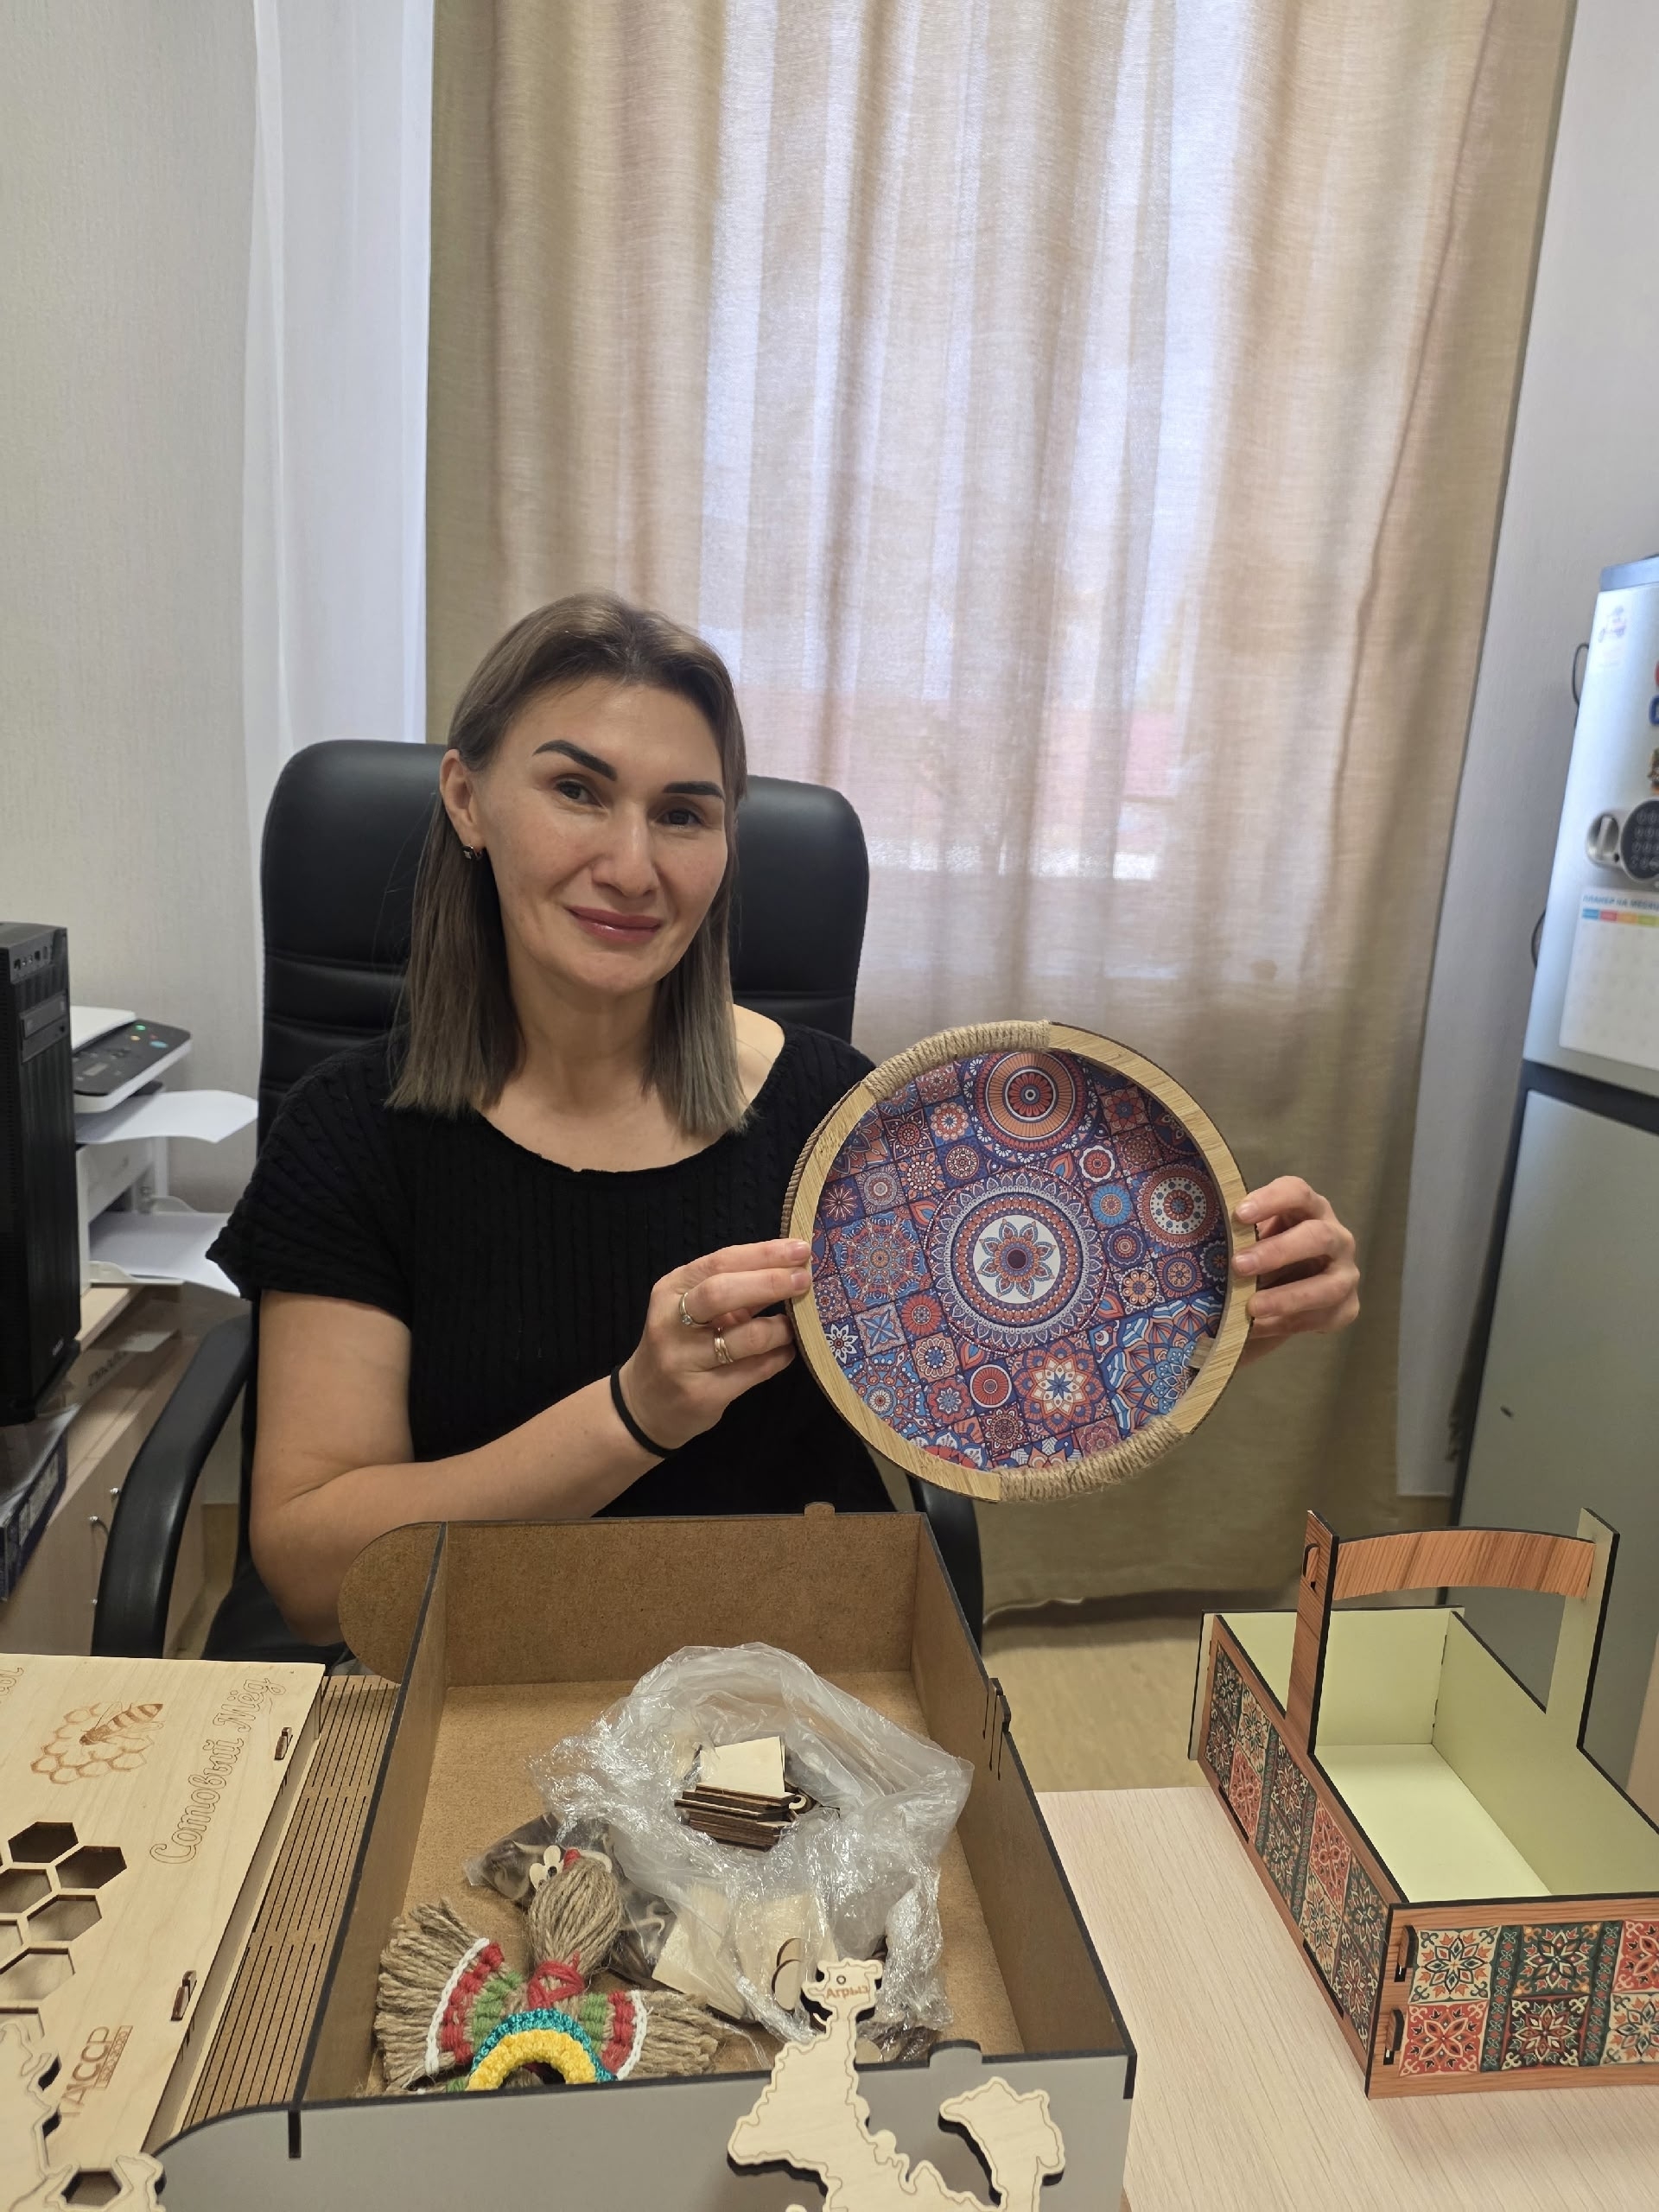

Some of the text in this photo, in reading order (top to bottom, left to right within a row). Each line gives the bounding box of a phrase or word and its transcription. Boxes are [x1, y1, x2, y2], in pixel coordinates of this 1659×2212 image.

[149, 1678, 287, 1864] Сотовый Мёд
[826, 1986, 869, 1999] Агрыз
